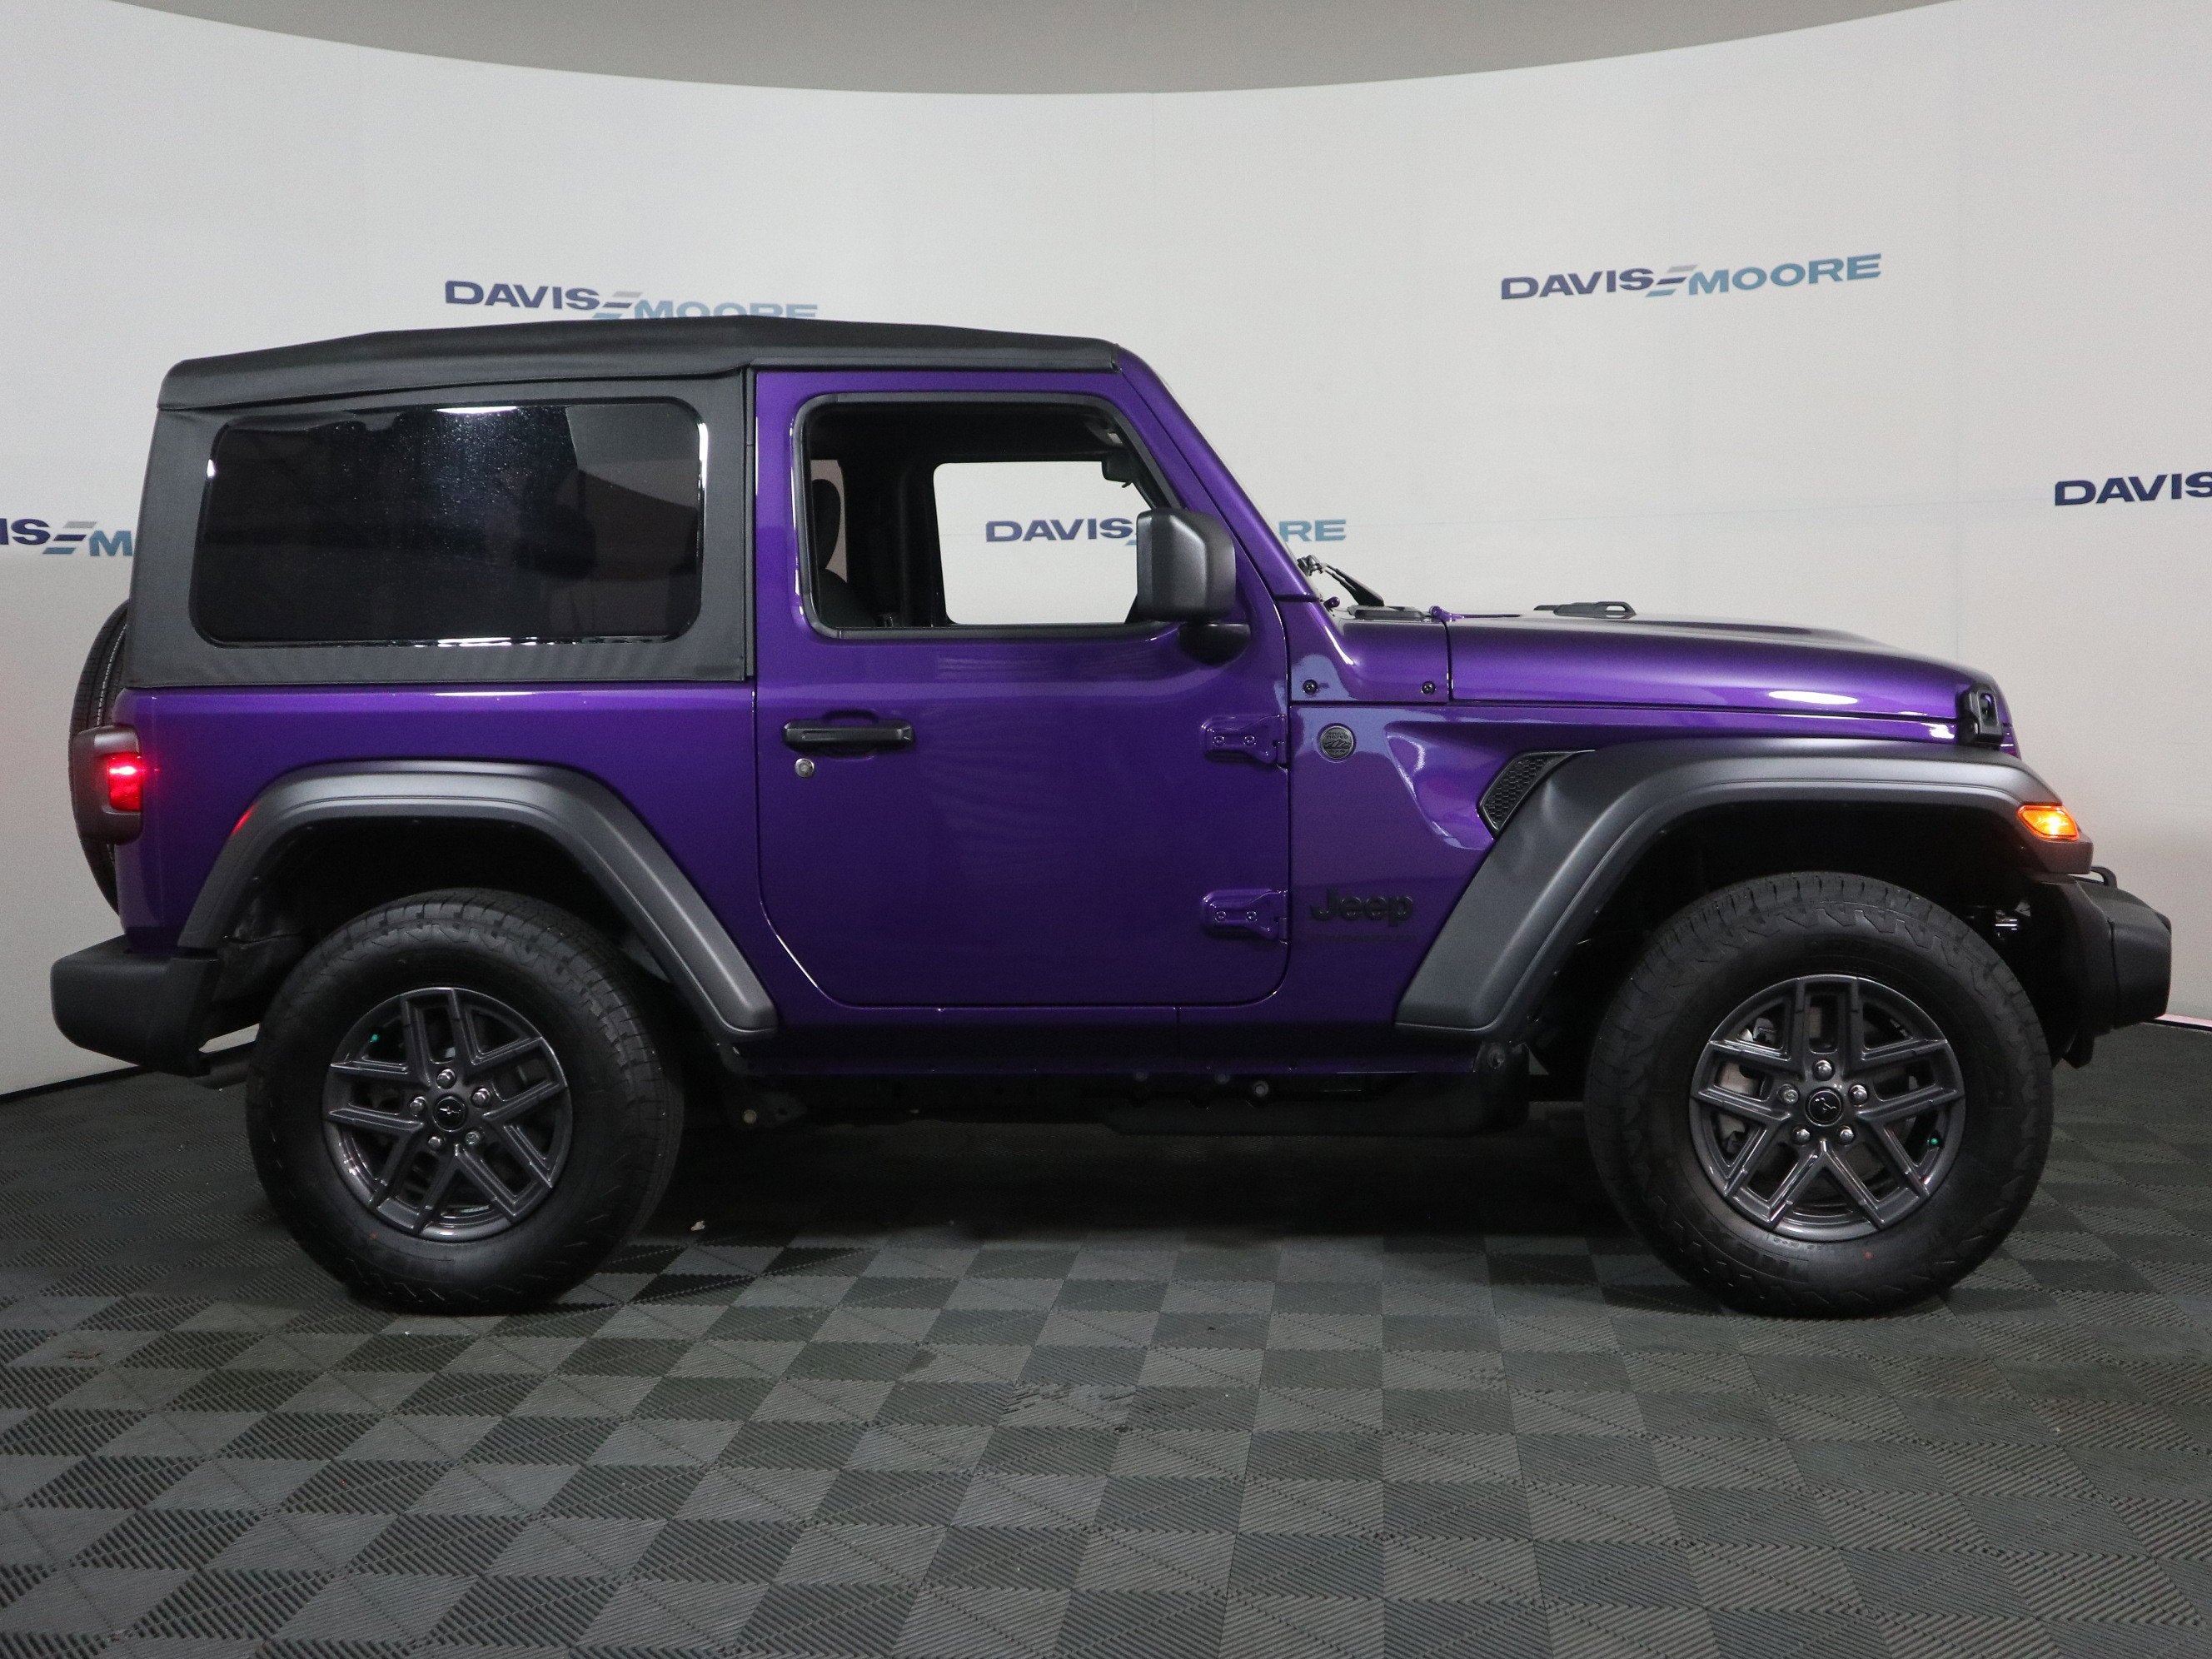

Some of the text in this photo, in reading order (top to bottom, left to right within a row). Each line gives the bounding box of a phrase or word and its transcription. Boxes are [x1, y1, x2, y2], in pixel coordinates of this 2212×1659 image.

[1501, 253, 1881, 300] DAVIS MOORE
[445, 281, 600, 310] DAVIS
[2055, 471, 2212, 506] DAVIS
[985, 517, 1133, 543] DAVIS
[1310, 888, 1413, 927] Jeep
